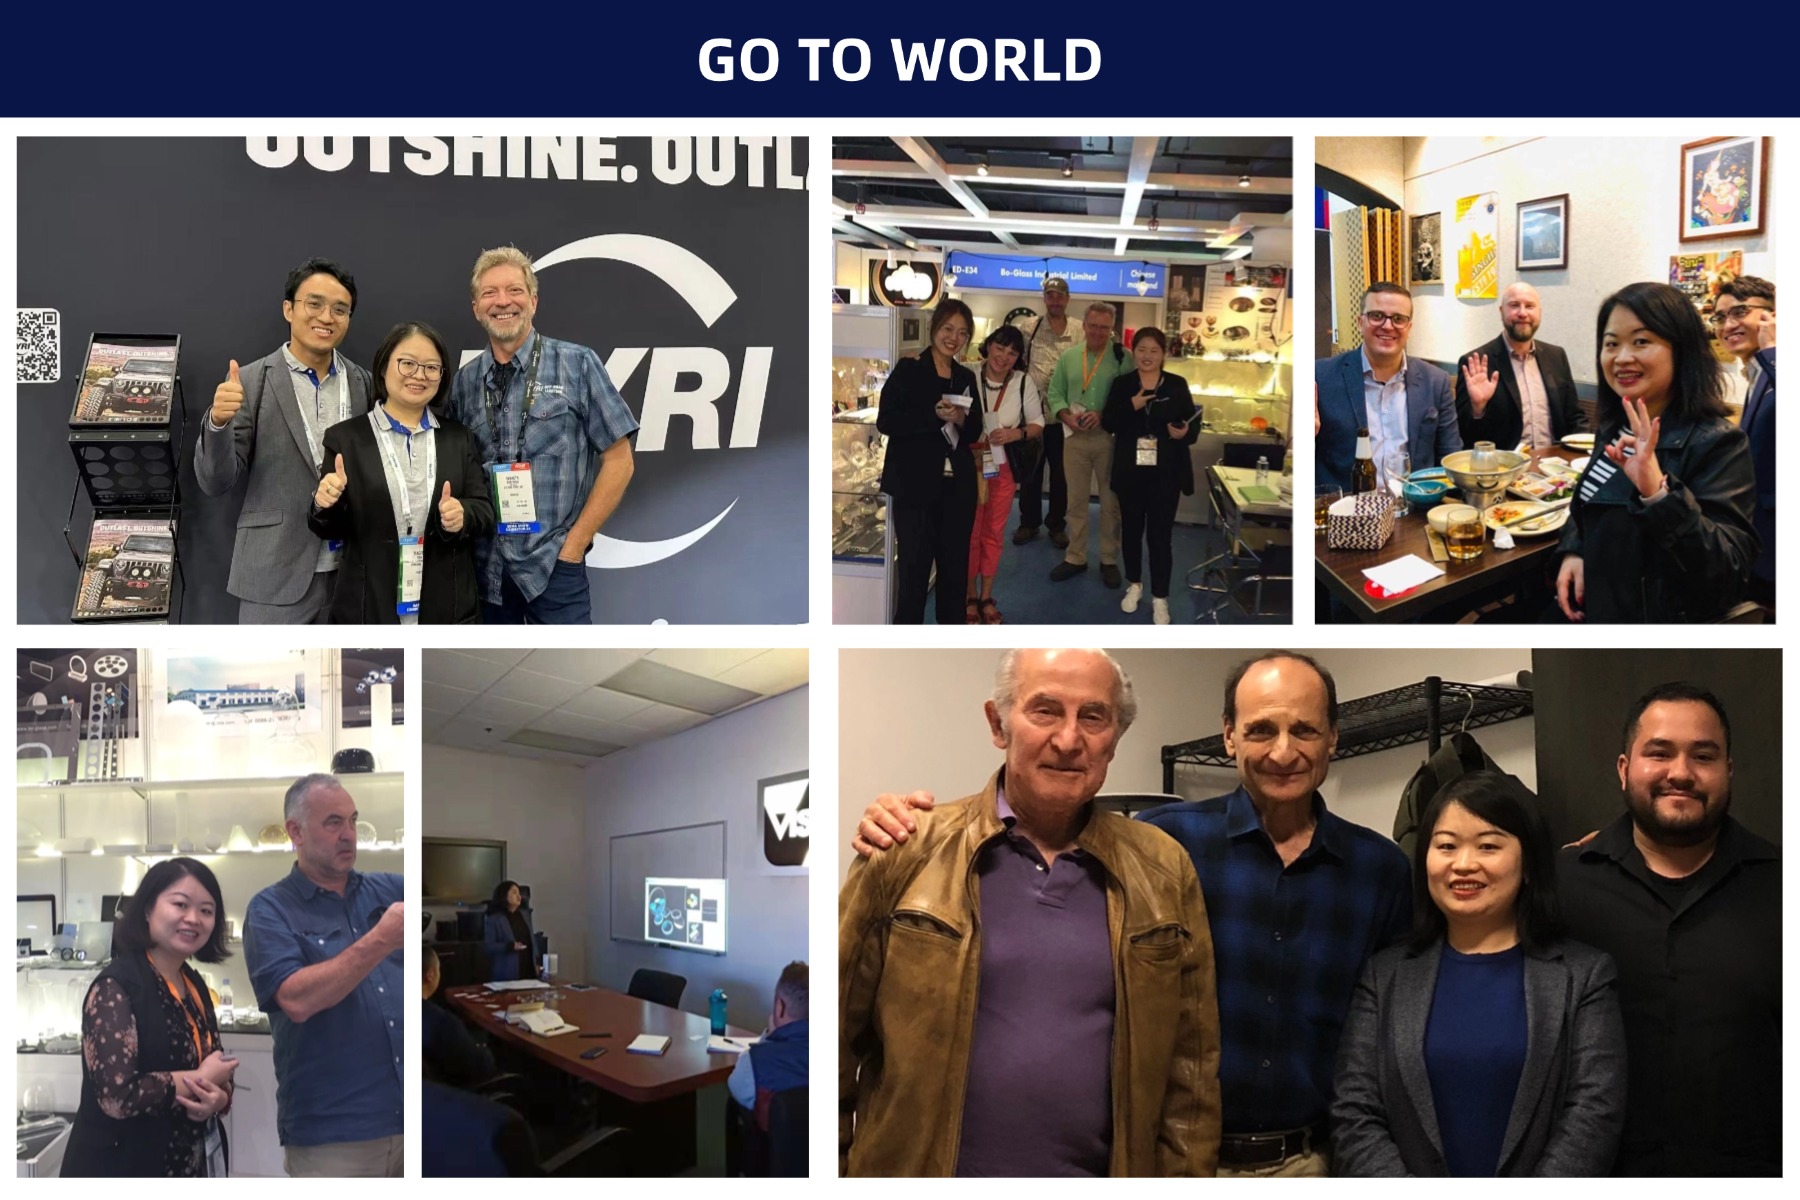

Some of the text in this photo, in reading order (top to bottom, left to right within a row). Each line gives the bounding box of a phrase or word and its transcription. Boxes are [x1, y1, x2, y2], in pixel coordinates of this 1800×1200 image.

[652, 136, 810, 191] OUTL
[1001, 268, 1033, 278] Bo-Glass
[1070, 271, 1098, 281] Limited
[457, 346, 774, 452] RI
